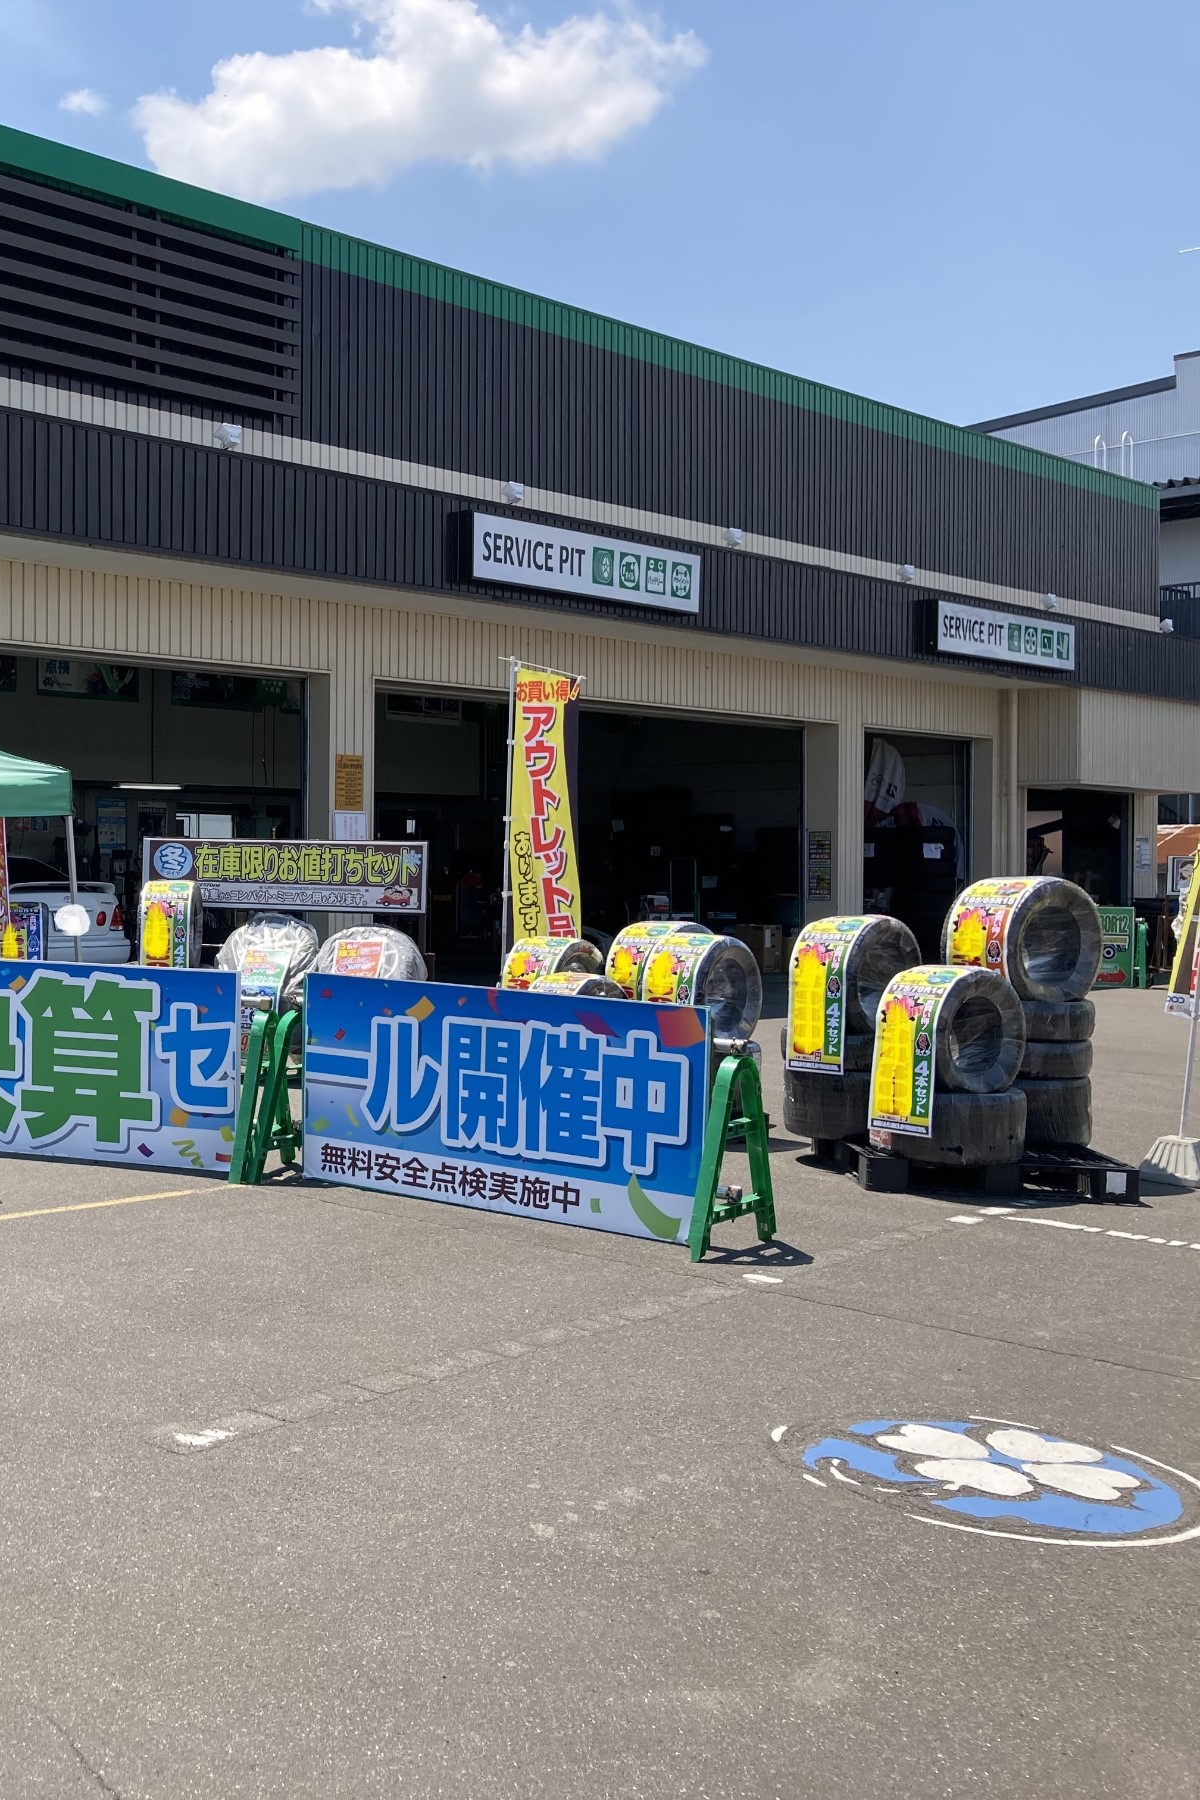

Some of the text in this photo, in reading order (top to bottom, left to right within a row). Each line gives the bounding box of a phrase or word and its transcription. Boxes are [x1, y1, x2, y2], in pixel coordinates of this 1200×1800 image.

[482, 531, 586, 577] SERVICE PIT
[943, 614, 1004, 646] SERVICE PIT
[521, 705, 578, 938] アウトレット品
[160, 845, 187, 871] 冬
[195, 842, 419, 886] 在庫限りお値打ちセット
[826, 1002, 840, 1054] 4本セット
[306, 1016, 688, 1174] ール開催中
[915, 1061, 930, 1115] 4本セット
[321, 1143, 581, 1214] 無料安全点検実施中
